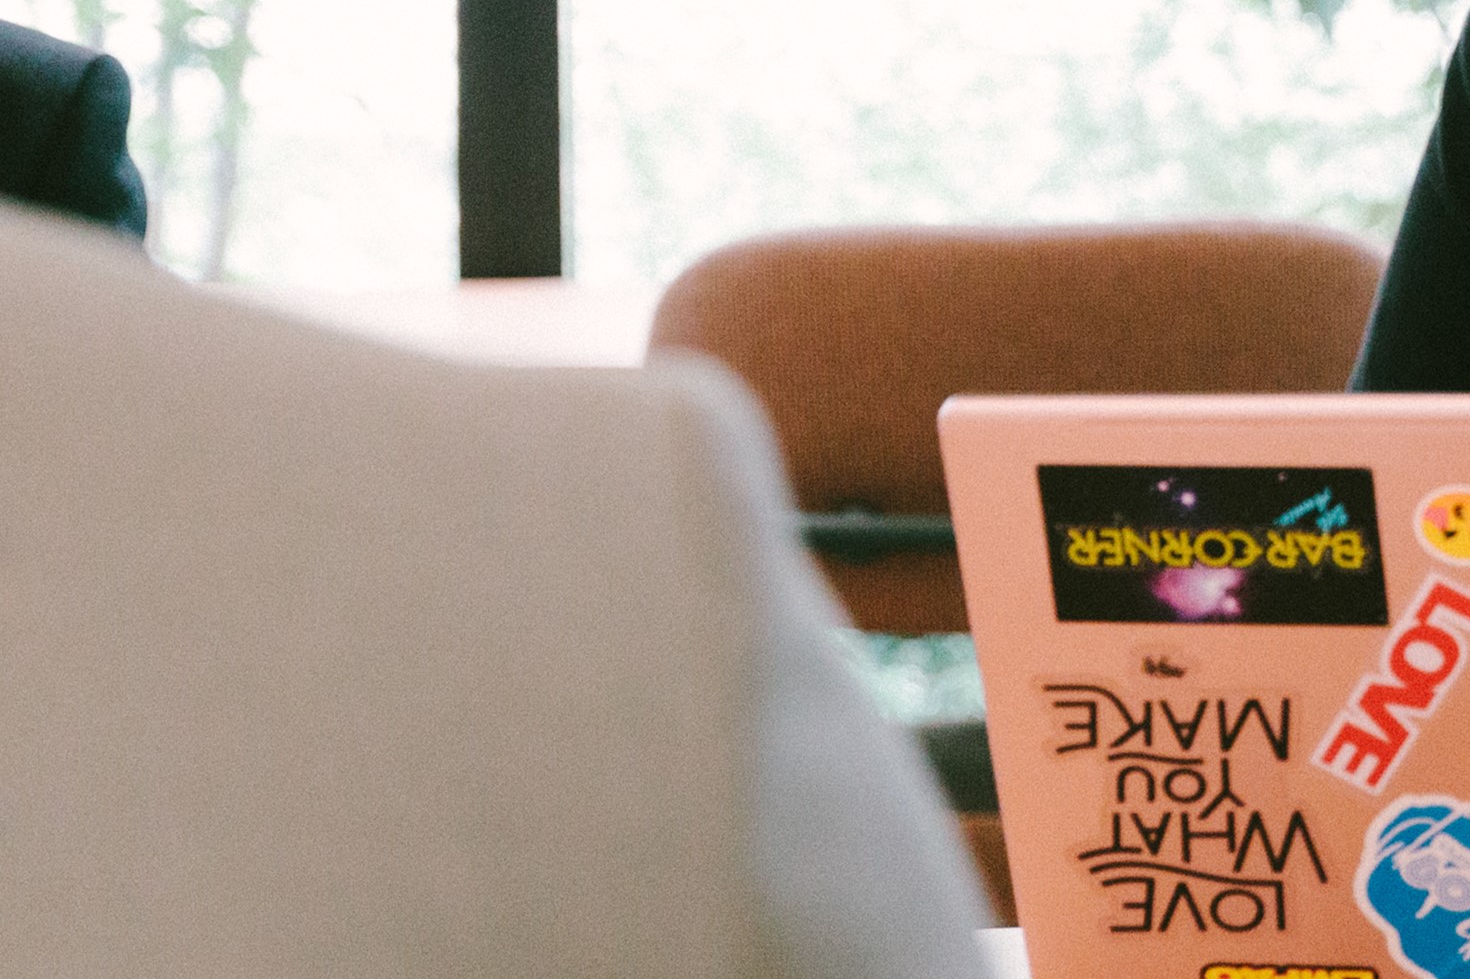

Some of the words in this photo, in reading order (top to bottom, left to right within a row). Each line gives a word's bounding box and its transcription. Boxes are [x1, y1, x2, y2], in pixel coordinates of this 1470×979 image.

[1065, 527, 1262, 567] CORNER
[1265, 528, 1365, 568] BAR
[1043, 684, 1291, 761] MAKE
[1107, 753, 1243, 820] YOU
[1077, 810, 1326, 883] WHAT
[1088, 861, 1285, 932] LOVE
